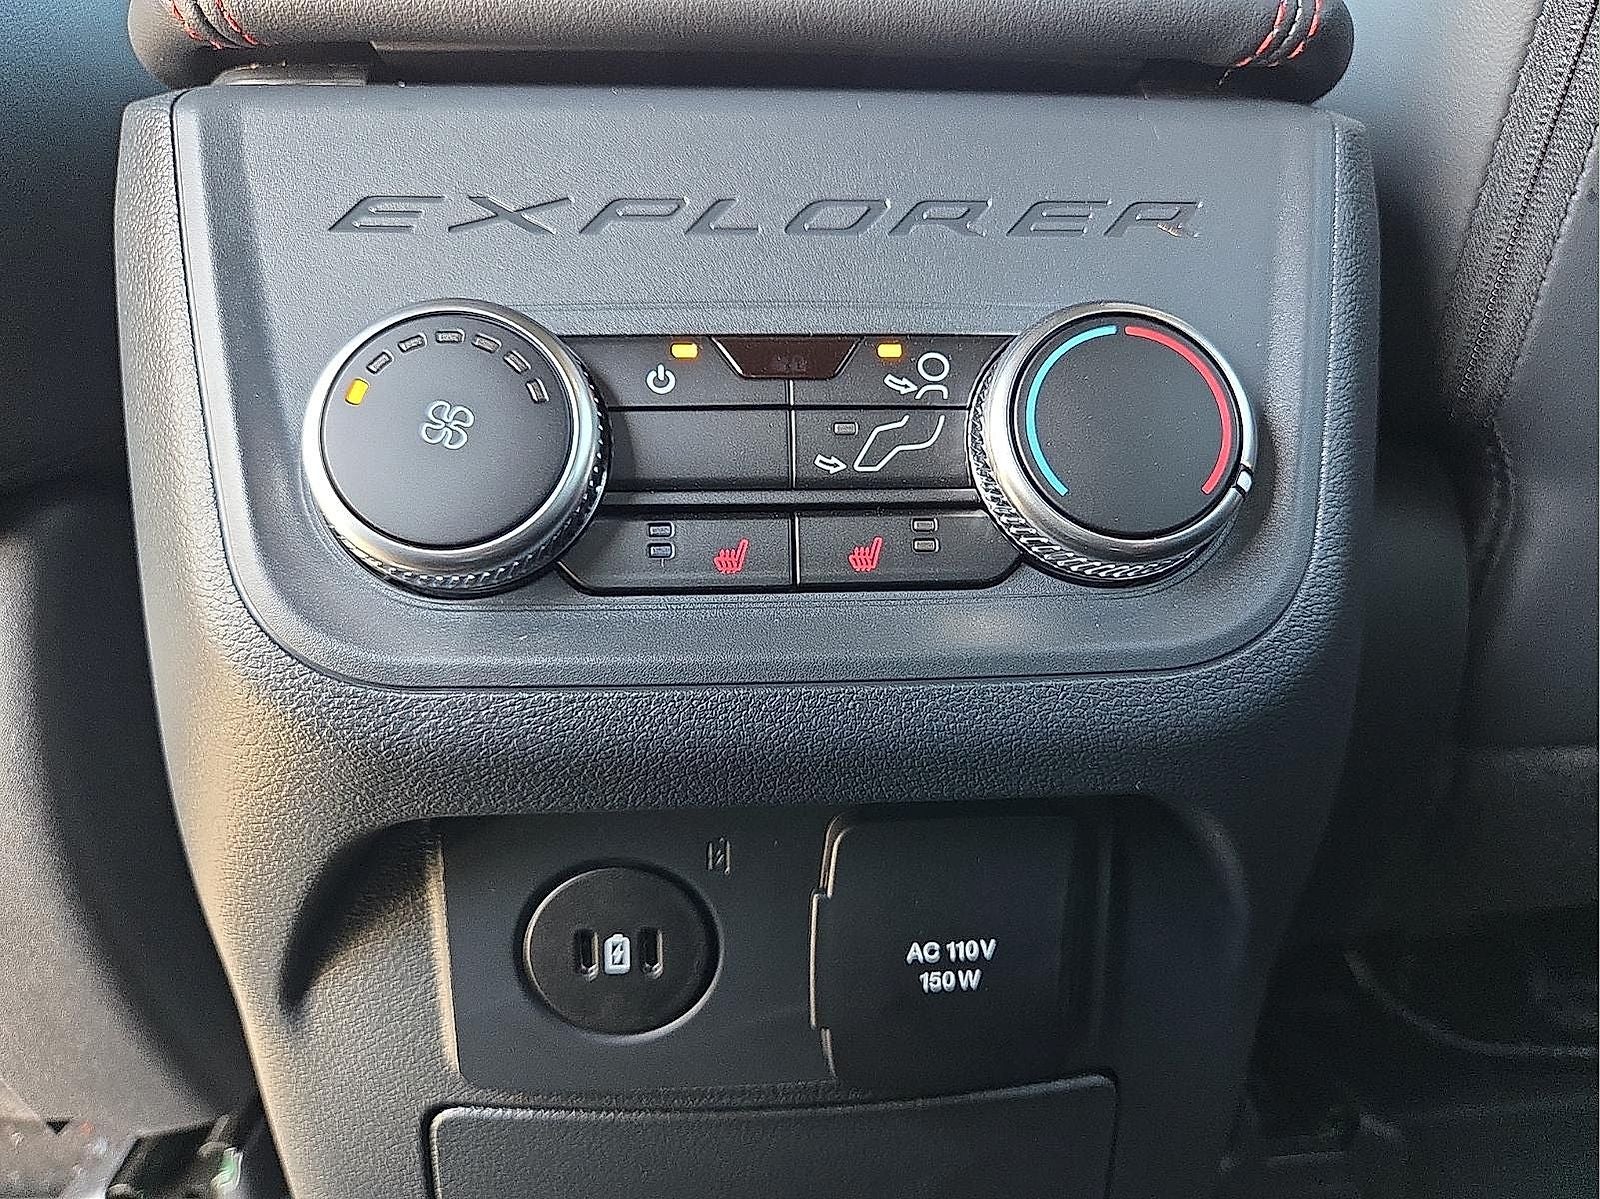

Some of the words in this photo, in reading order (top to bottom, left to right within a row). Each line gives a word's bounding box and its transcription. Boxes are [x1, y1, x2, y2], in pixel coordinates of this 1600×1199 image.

[328, 195, 1203, 239] EXPLORER
[906, 941, 941, 965] AC
[946, 938, 997, 963] 110V
[919, 968, 982, 994] 150W
